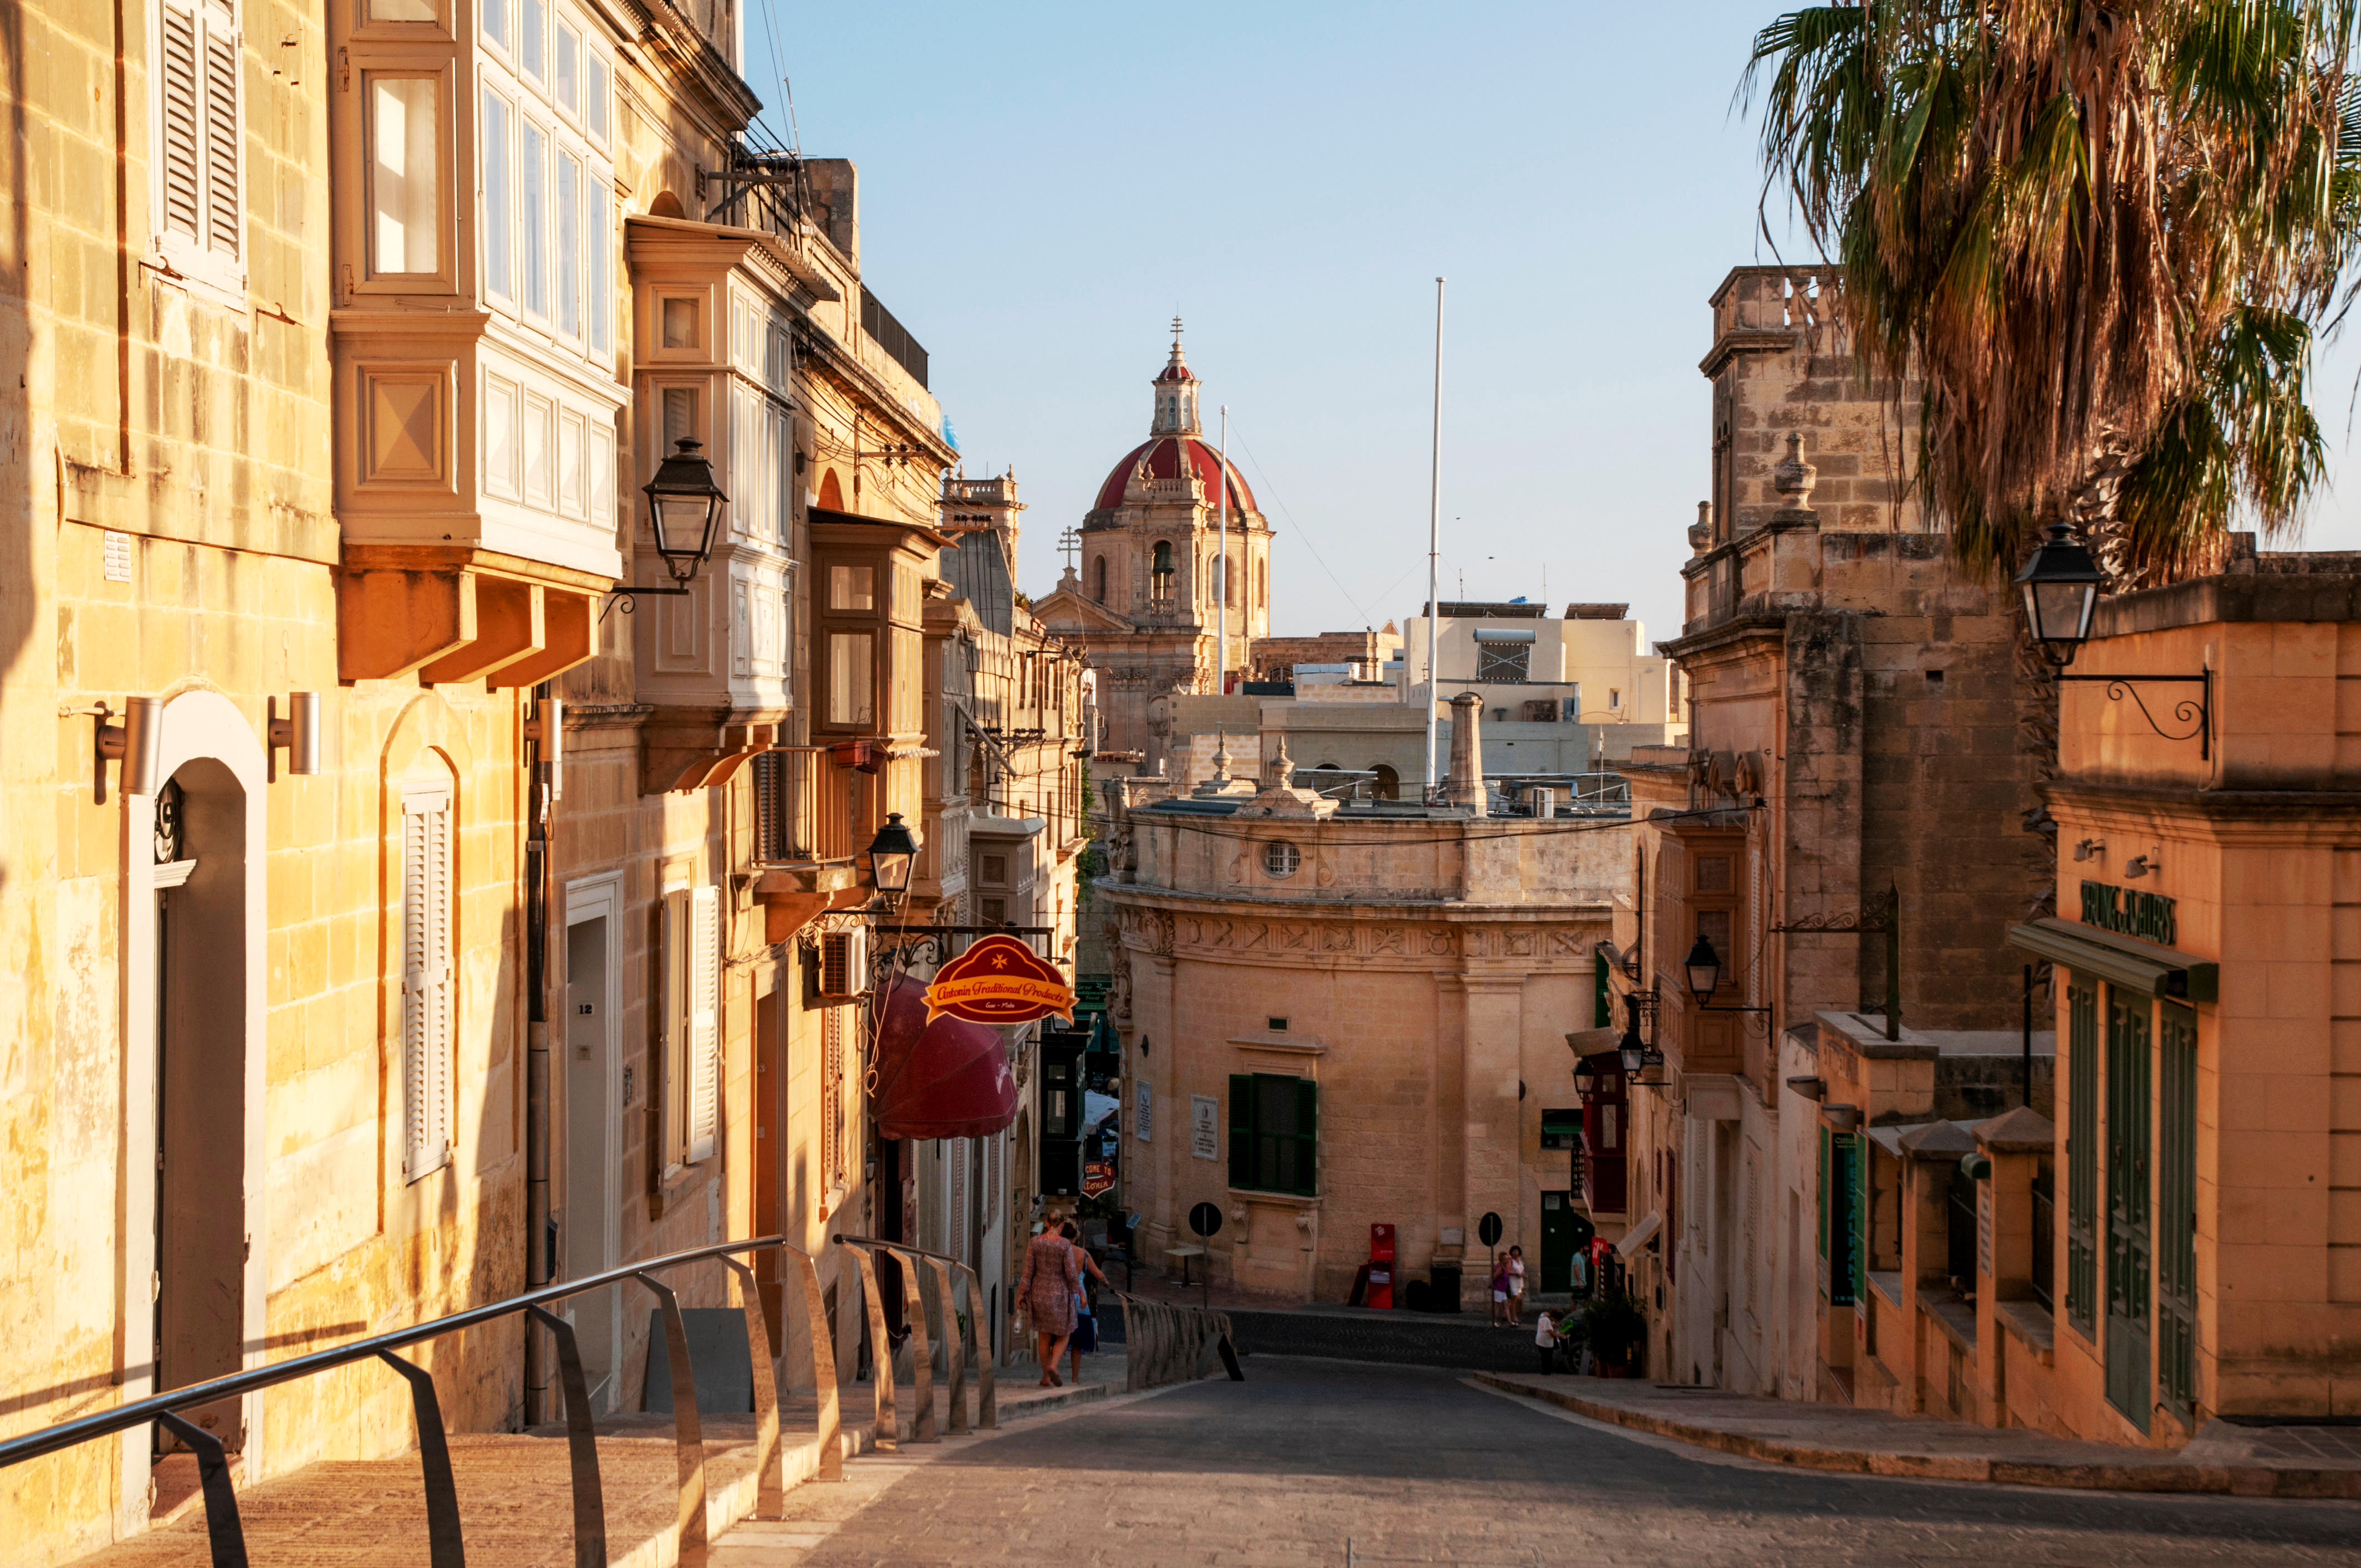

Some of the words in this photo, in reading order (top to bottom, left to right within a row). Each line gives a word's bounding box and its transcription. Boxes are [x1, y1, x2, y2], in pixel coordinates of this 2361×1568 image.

[937, 985, 971, 1000] Antonin
[972, 981, 1023, 995] Traditional
[1023, 982, 1064, 1003] Products
[579, 1004, 592, 1015] 12
[1104, 1166, 1111, 1176] TO
[1847, 1153, 1856, 1289] RESTAURANT
